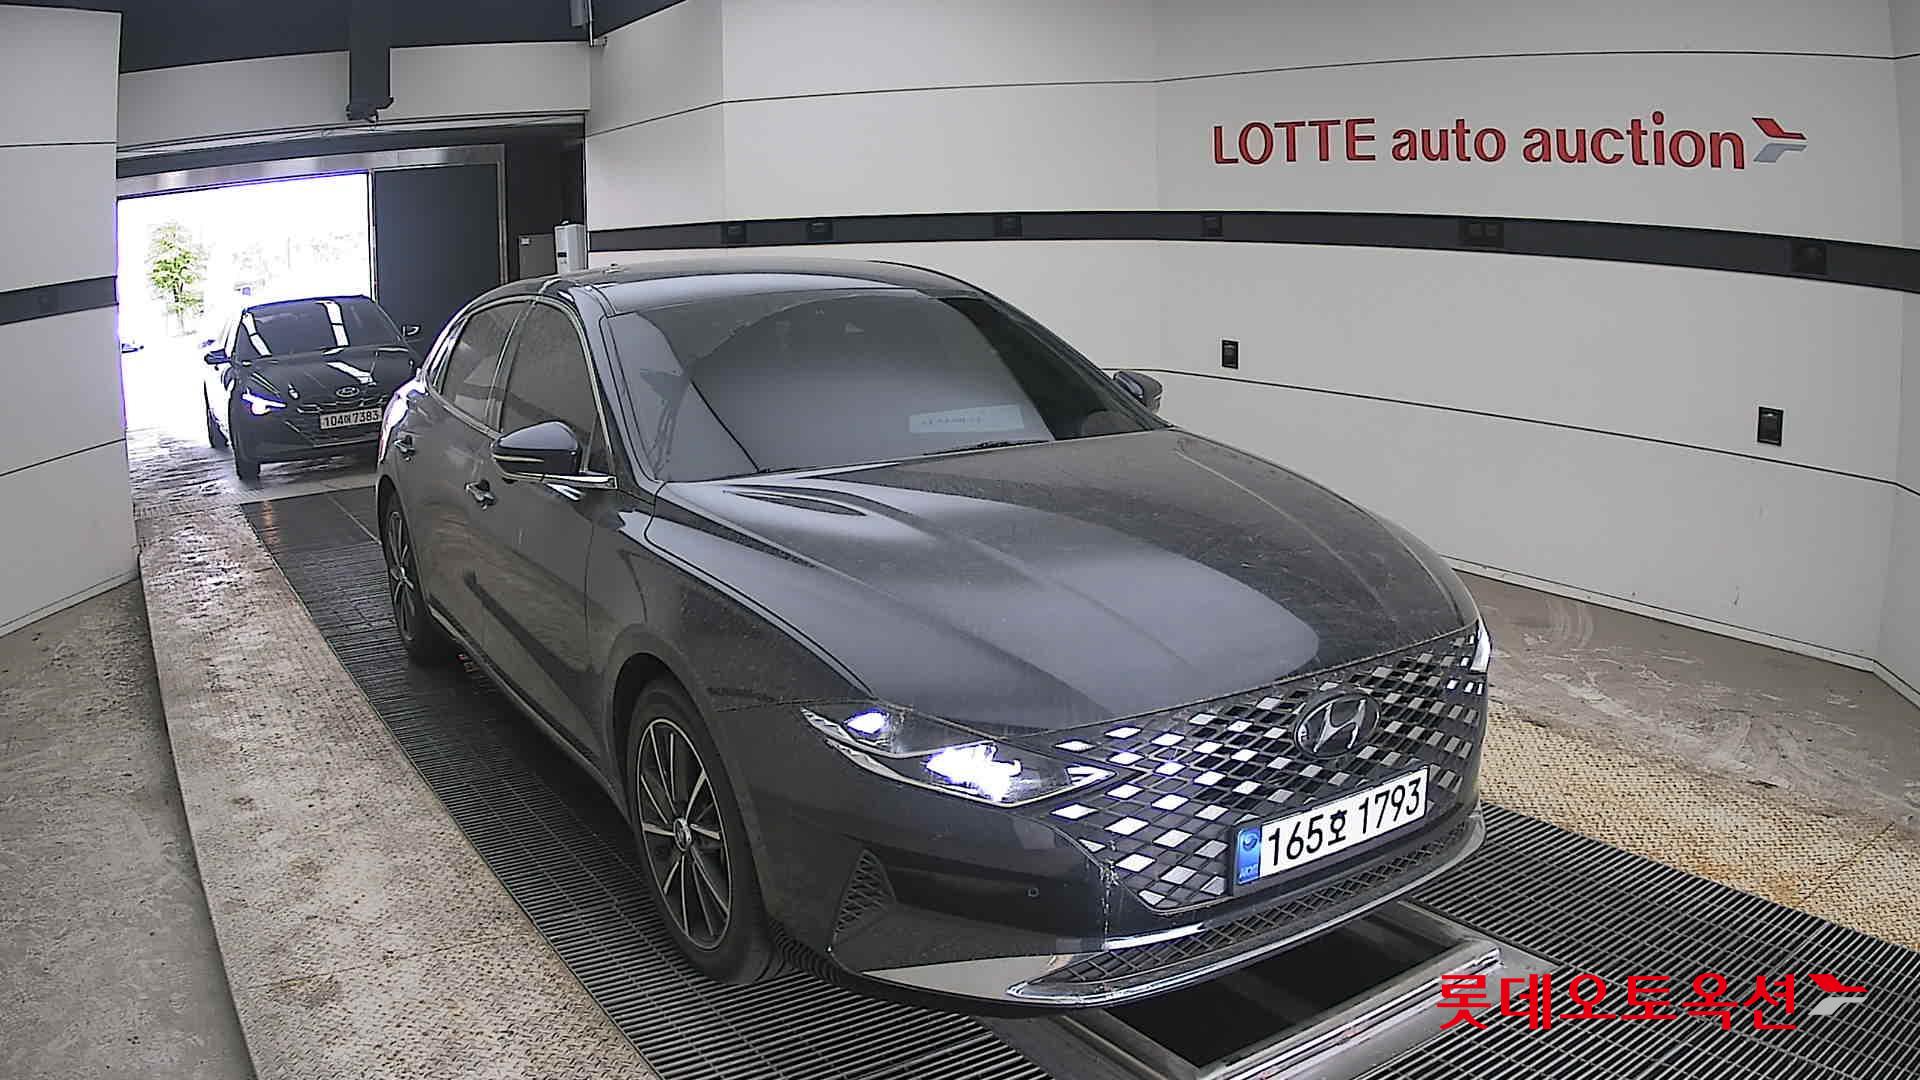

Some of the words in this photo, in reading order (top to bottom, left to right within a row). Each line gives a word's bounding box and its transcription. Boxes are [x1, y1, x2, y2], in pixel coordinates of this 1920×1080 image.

[1214, 118, 1376, 164] LOTTE
[1391, 119, 1507, 162] auto
[1523, 112, 1745, 169] auction
[1268, 810, 1348, 866] 165호
[1358, 777, 1421, 834] 1793
